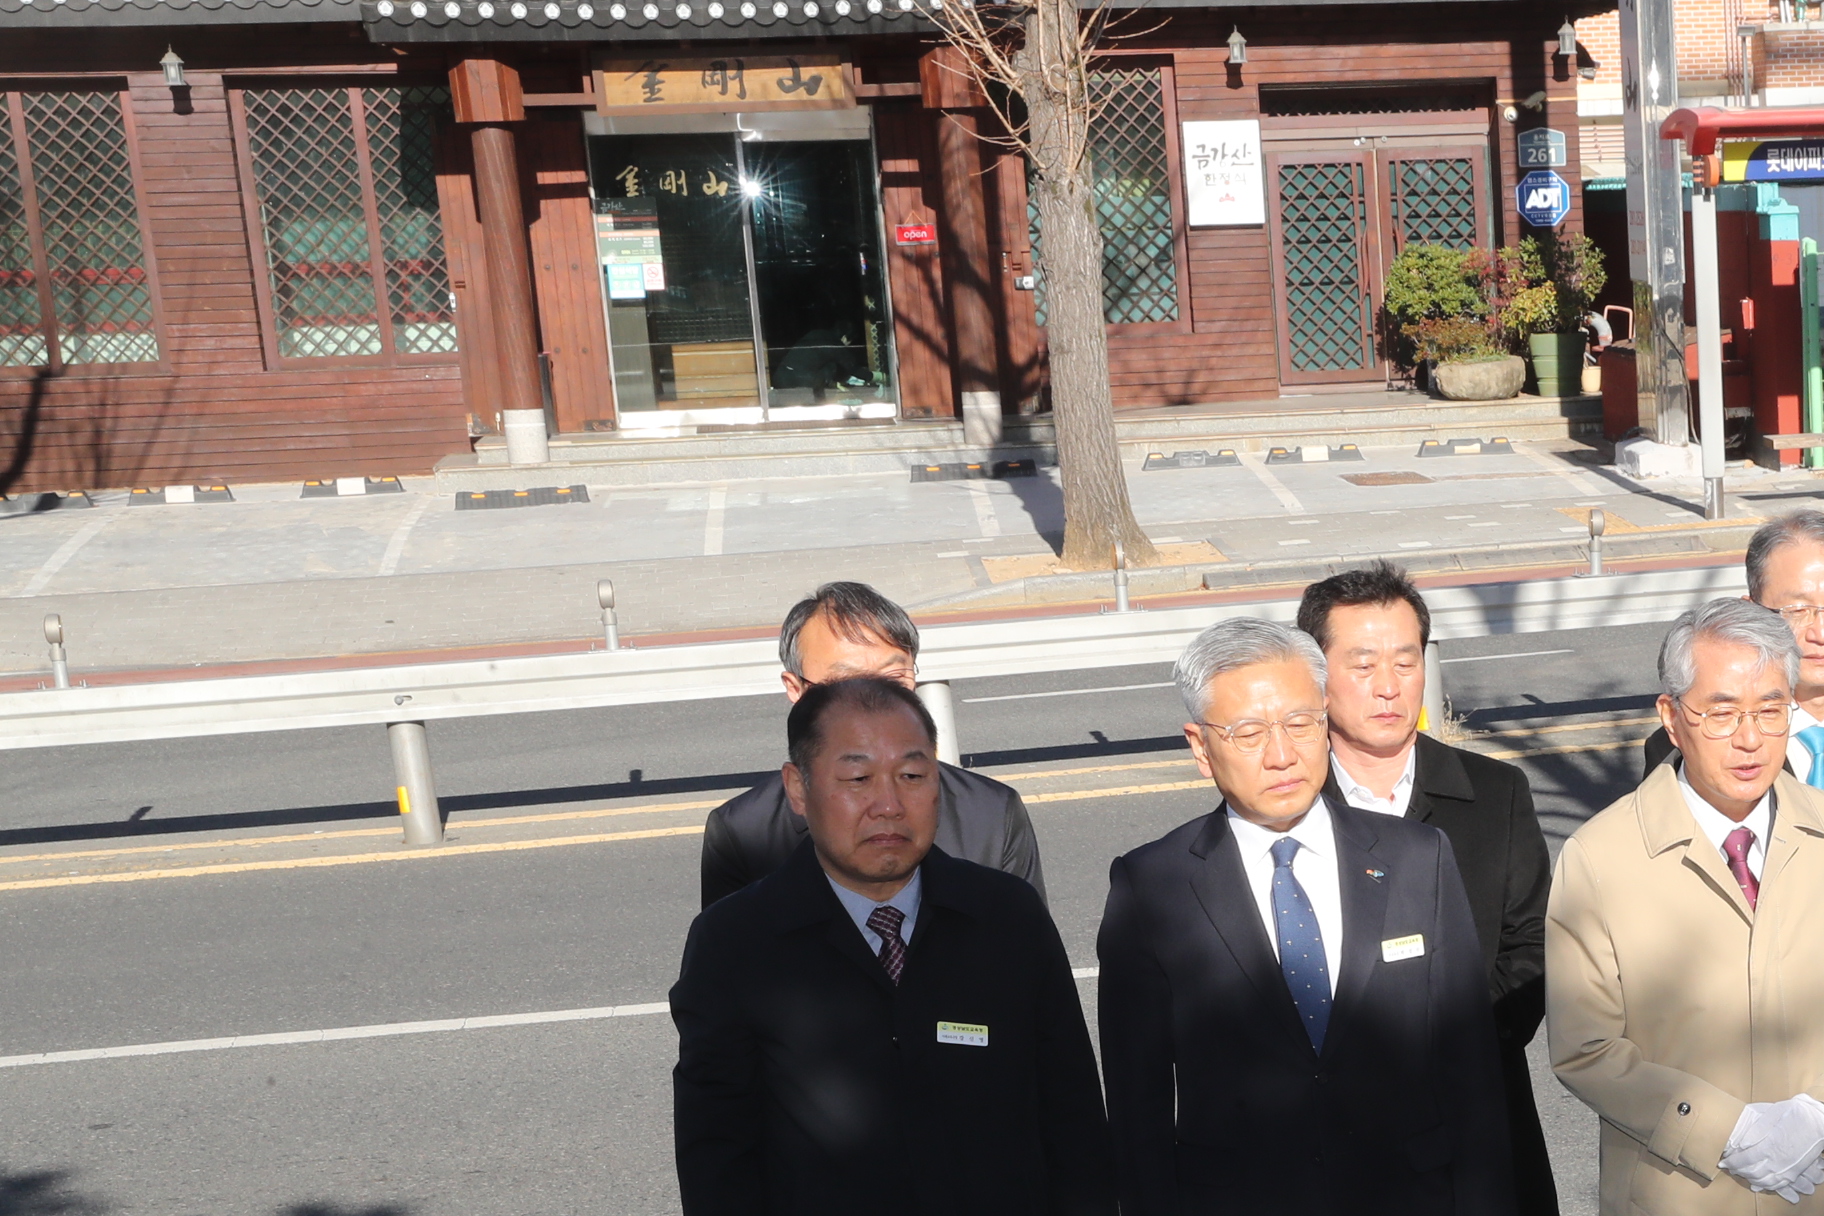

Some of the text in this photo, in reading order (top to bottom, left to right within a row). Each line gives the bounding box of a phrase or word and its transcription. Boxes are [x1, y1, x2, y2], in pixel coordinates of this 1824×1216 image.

[624, 57, 824, 103] 金剛山
[1192, 142, 1254, 170] 금강산
[1527, 147, 1556, 163] 261
[615, 165, 729, 198] 金剛山
[1204, 173, 1247, 187] 한정식
[1525, 188, 1561, 208] ADT
[903, 230, 928, 240] open
